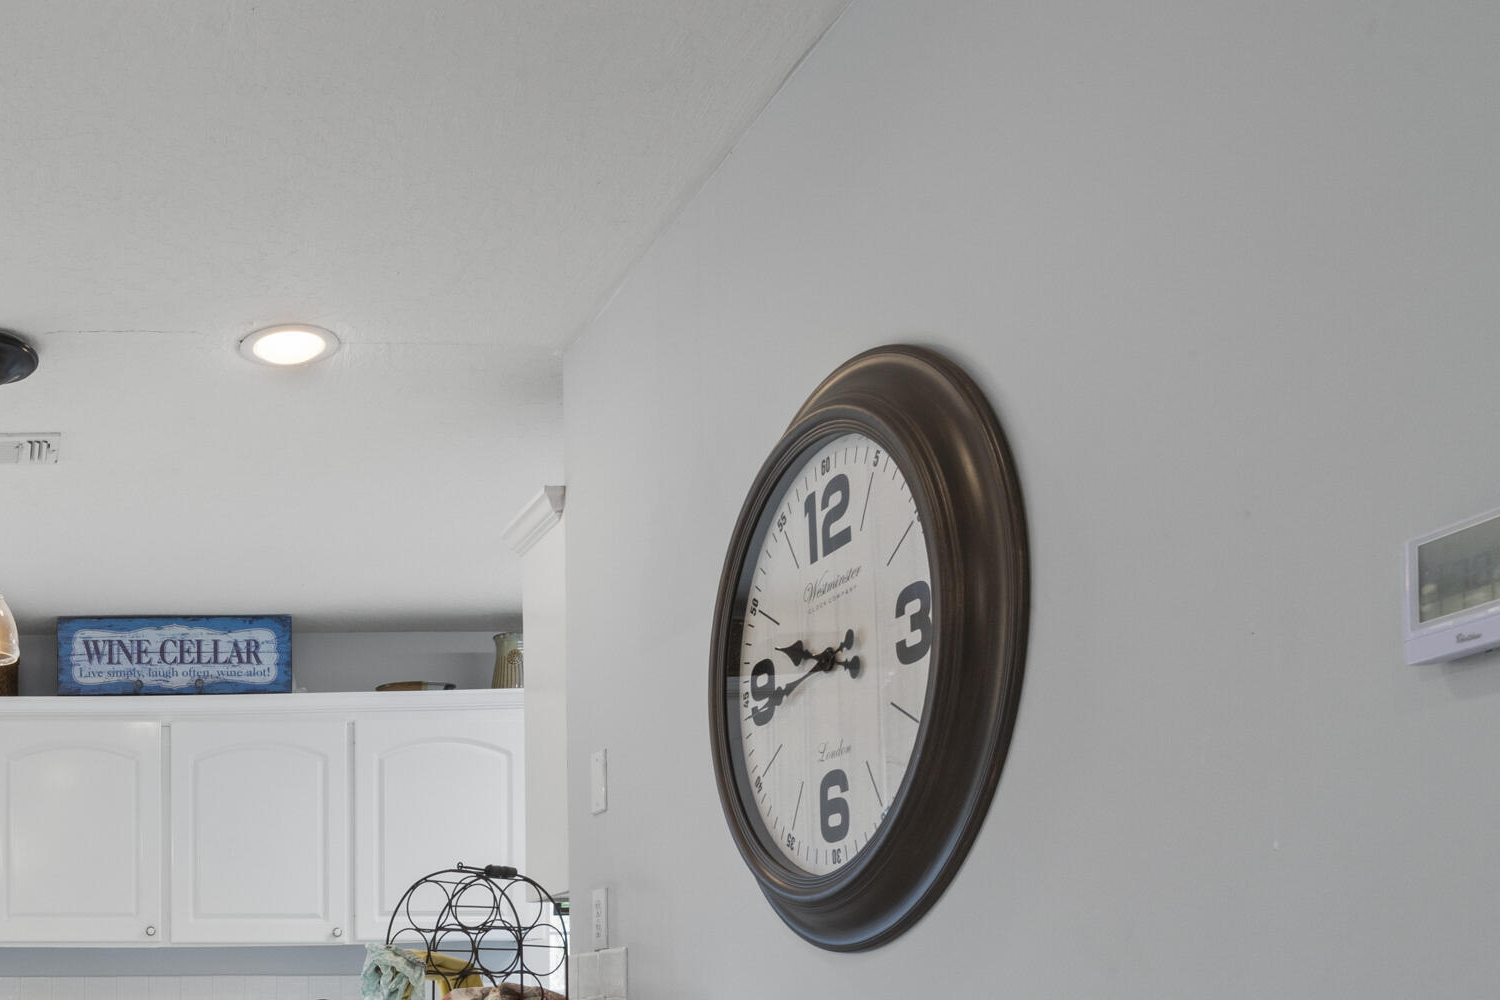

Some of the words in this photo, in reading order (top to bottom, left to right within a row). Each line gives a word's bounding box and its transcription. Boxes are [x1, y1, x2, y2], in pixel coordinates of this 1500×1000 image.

[821, 456, 831, 476] 60
[873, 450, 881, 467] 5
[777, 512, 787, 533] 55
[804, 473, 852, 565] 12
[750, 598, 759, 616] 50
[895, 580, 933, 665] 3
[82, 639, 152, 665] WINE
[159, 638, 263, 665] CELLAR
[79, 667, 104, 678] Live
[149, 667, 178, 679] laugh
[751, 658, 775, 726] 9
[820, 768, 849, 843] 6
